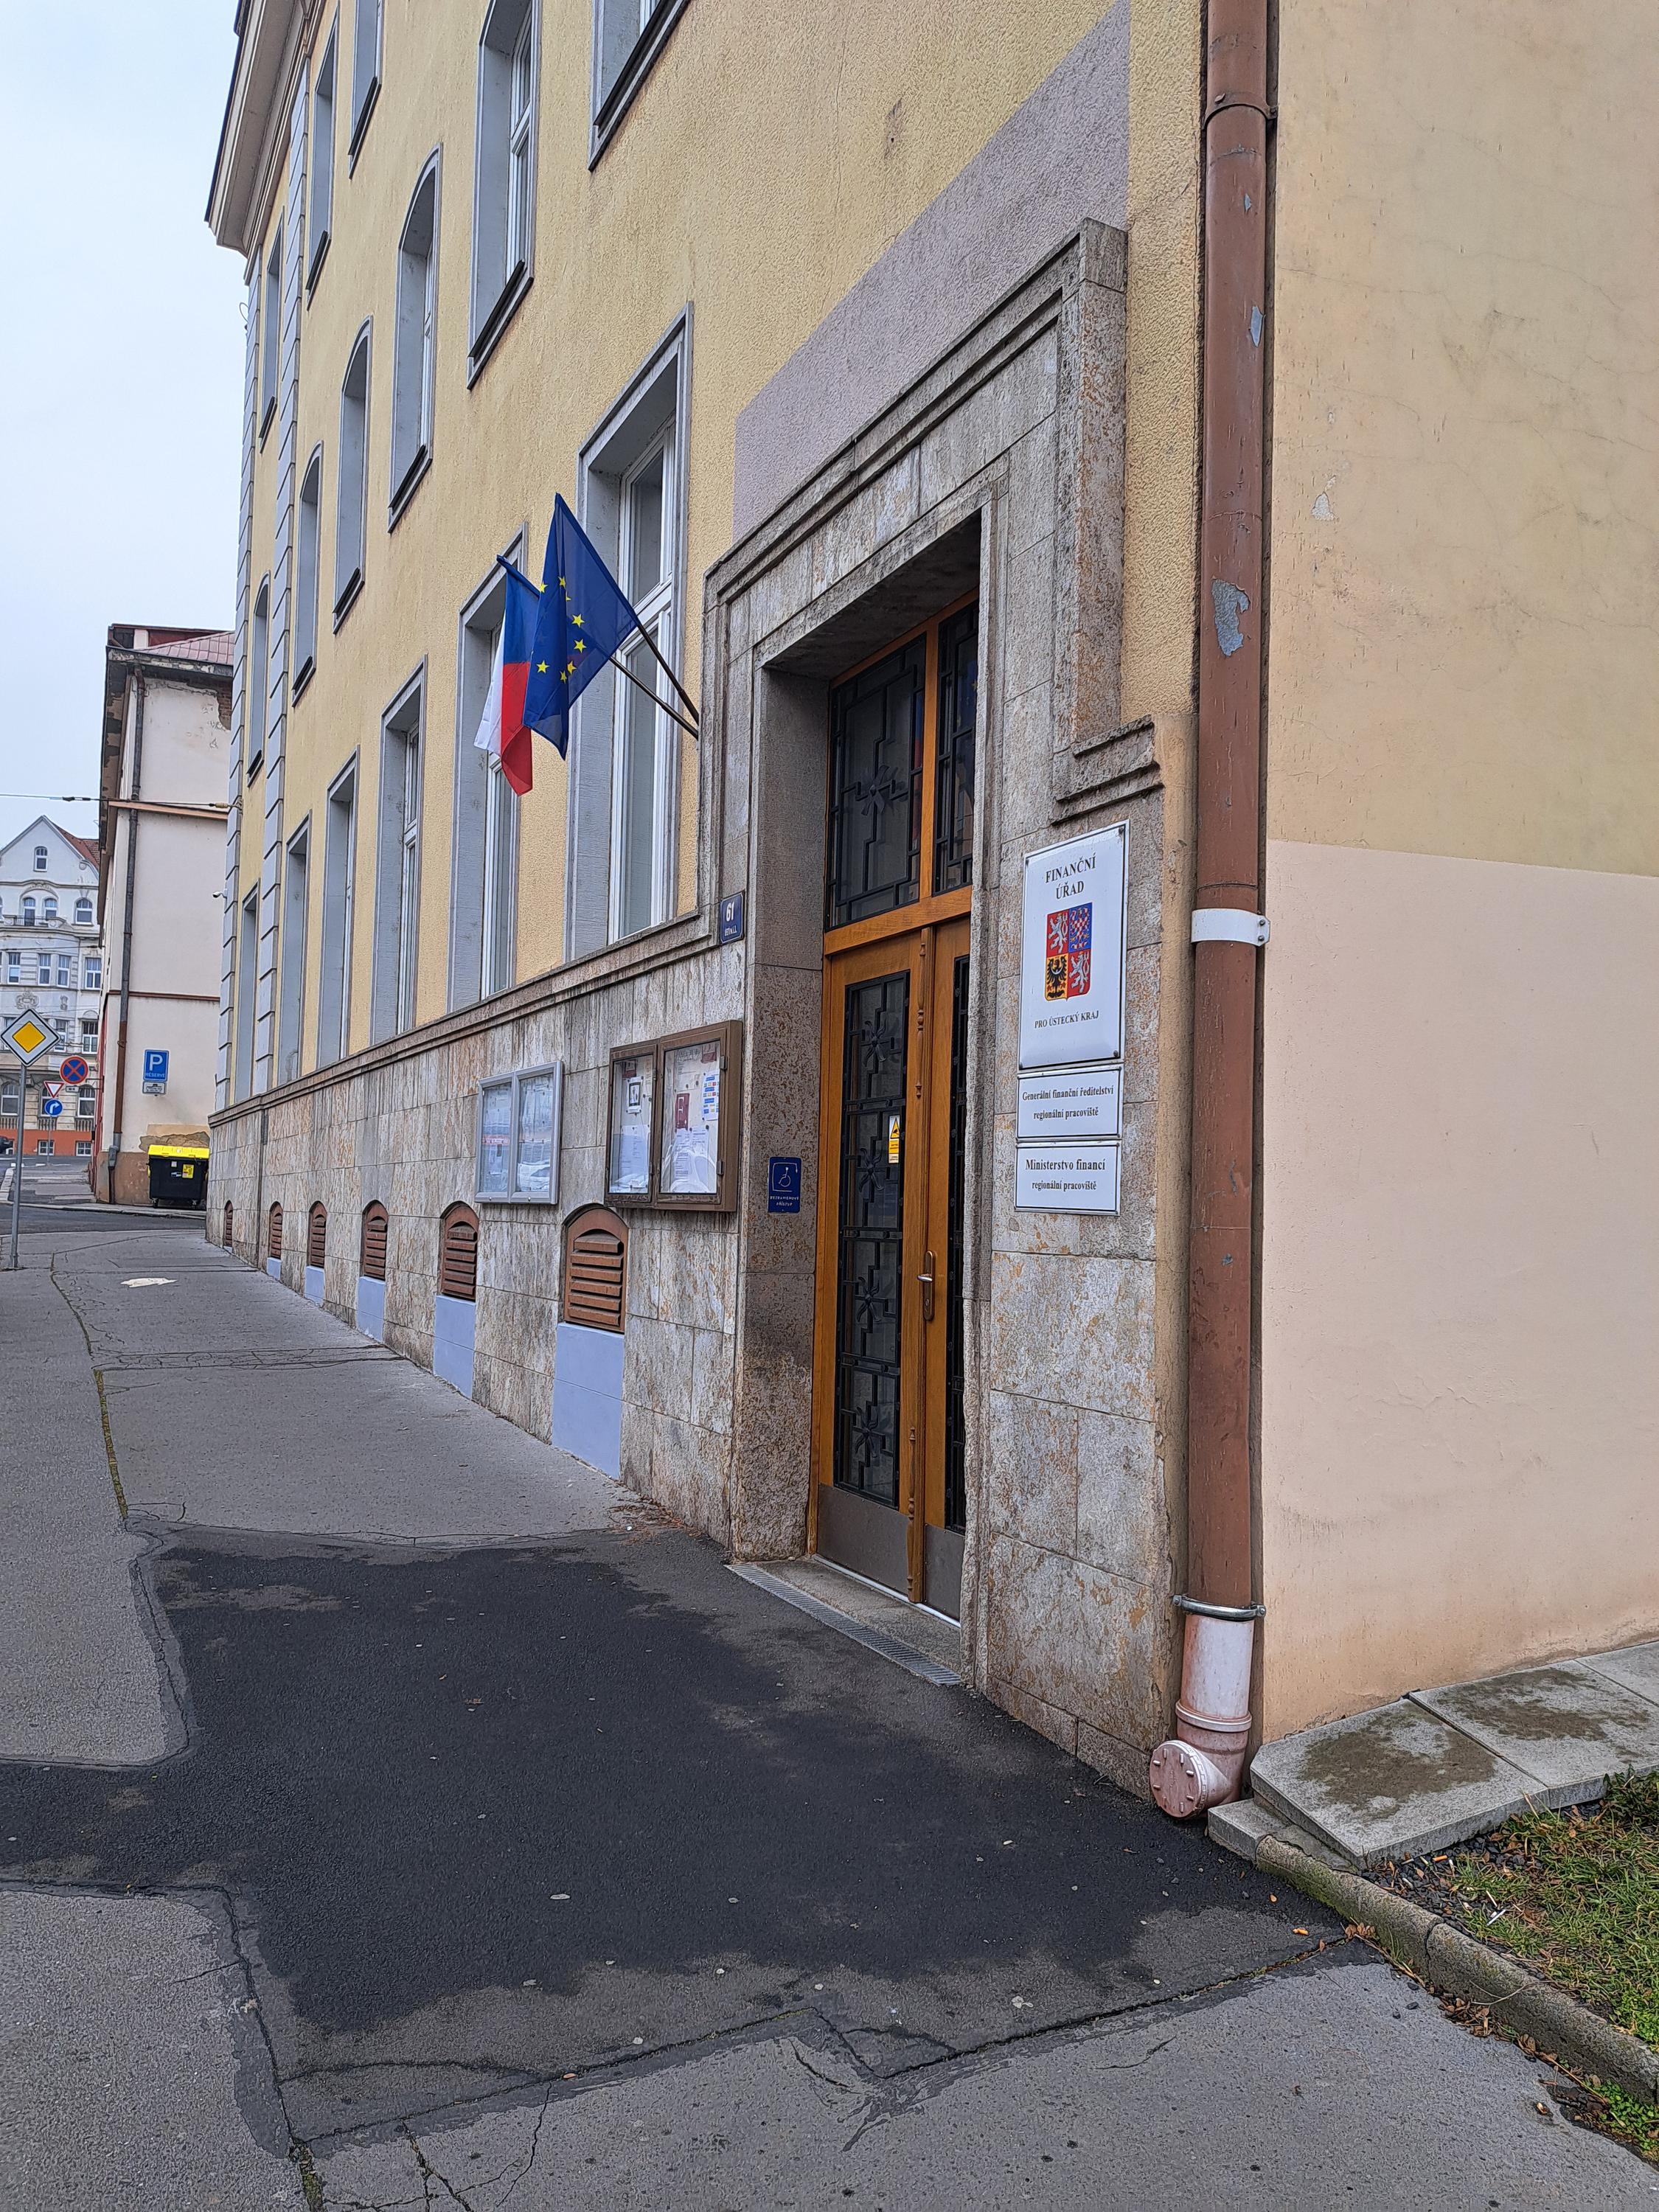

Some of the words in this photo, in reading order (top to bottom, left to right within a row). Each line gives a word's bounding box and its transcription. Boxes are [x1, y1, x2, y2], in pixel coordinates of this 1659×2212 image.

[1046, 852, 1096, 883] FINANČNÍ
[1056, 881, 1084, 900] ÚŘAD
[726, 901, 734, 922] 61
[1034, 1019, 1048, 1029] PRO
[1049, 1012, 1079, 1026] ÚSTECKÝ
[1081, 1010, 1099, 1021] KRAJ
[149, 1054, 163, 1071] P
[1022, 1090, 1051, 1101] Generální
[1052, 1088, 1079, 1099] finanční
[1080, 1085, 1114, 1096] ředitelství
[1034, 1108, 1064, 1121] regionální
[1065, 1107, 1099, 1120] pracoviště
[1026, 1159, 1074, 1170] Ministerstvo
[1076, 1158, 1105, 1170] financí
[1032, 1180, 1062, 1192] regionální
[1063, 1180, 1097, 1192] pracoviště
